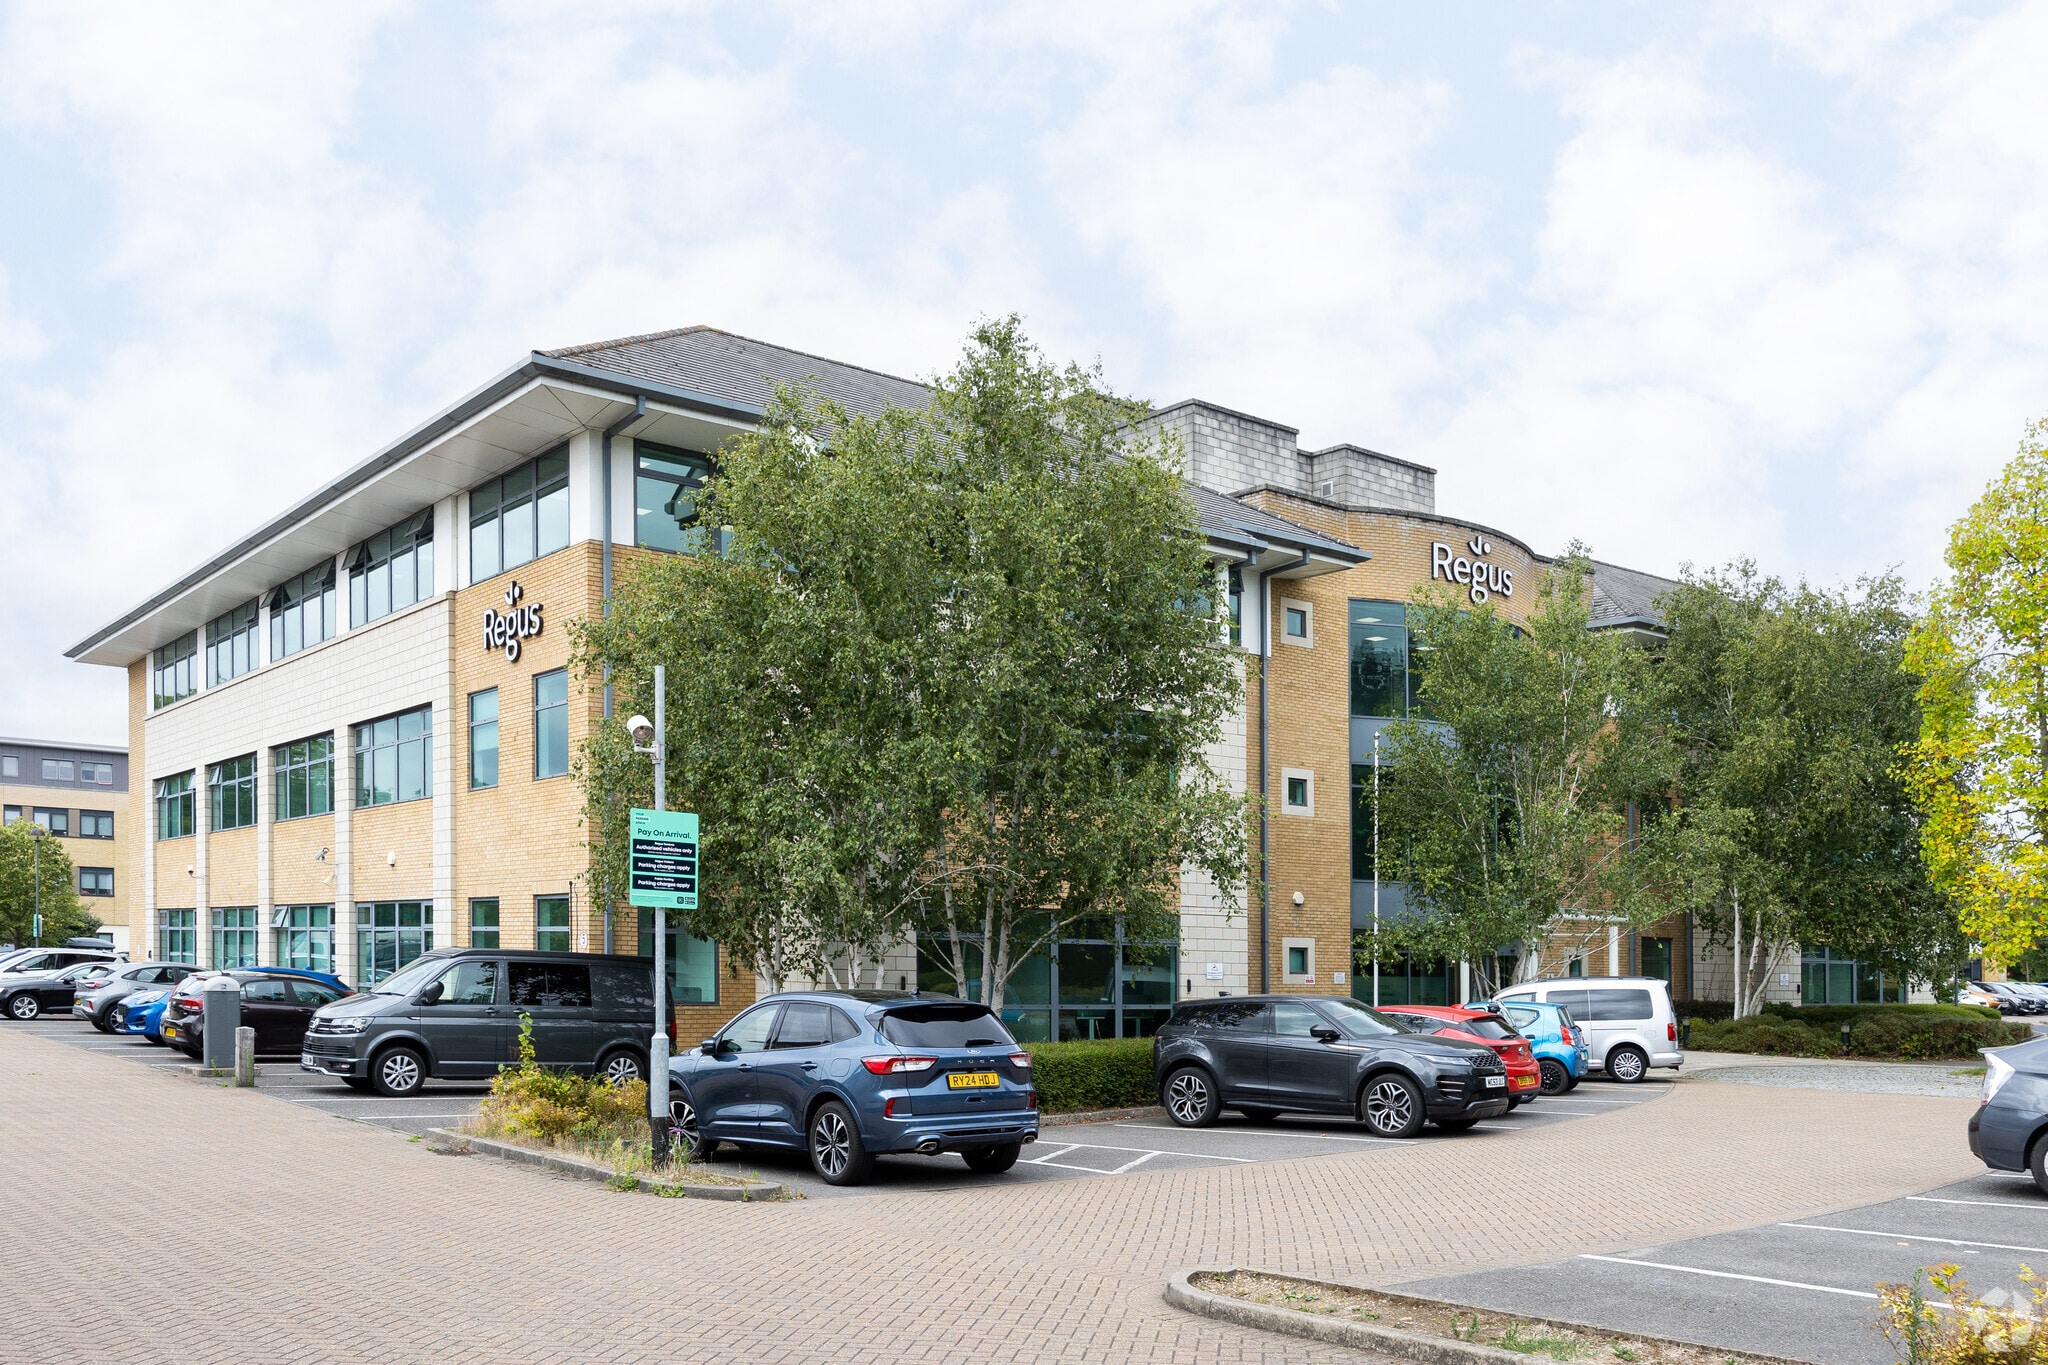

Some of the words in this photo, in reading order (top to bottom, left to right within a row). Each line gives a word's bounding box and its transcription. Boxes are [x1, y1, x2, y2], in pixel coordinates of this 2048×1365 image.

[1432, 541, 1513, 605] Regus
[483, 602, 543, 662] Regus
[637, 828, 652, 837] Pay
[653, 829, 664, 837] On
[665, 831, 692, 839] Arrival.
[952, 1075, 976, 1086] RY24
[977, 1074, 996, 1085] HDJ
